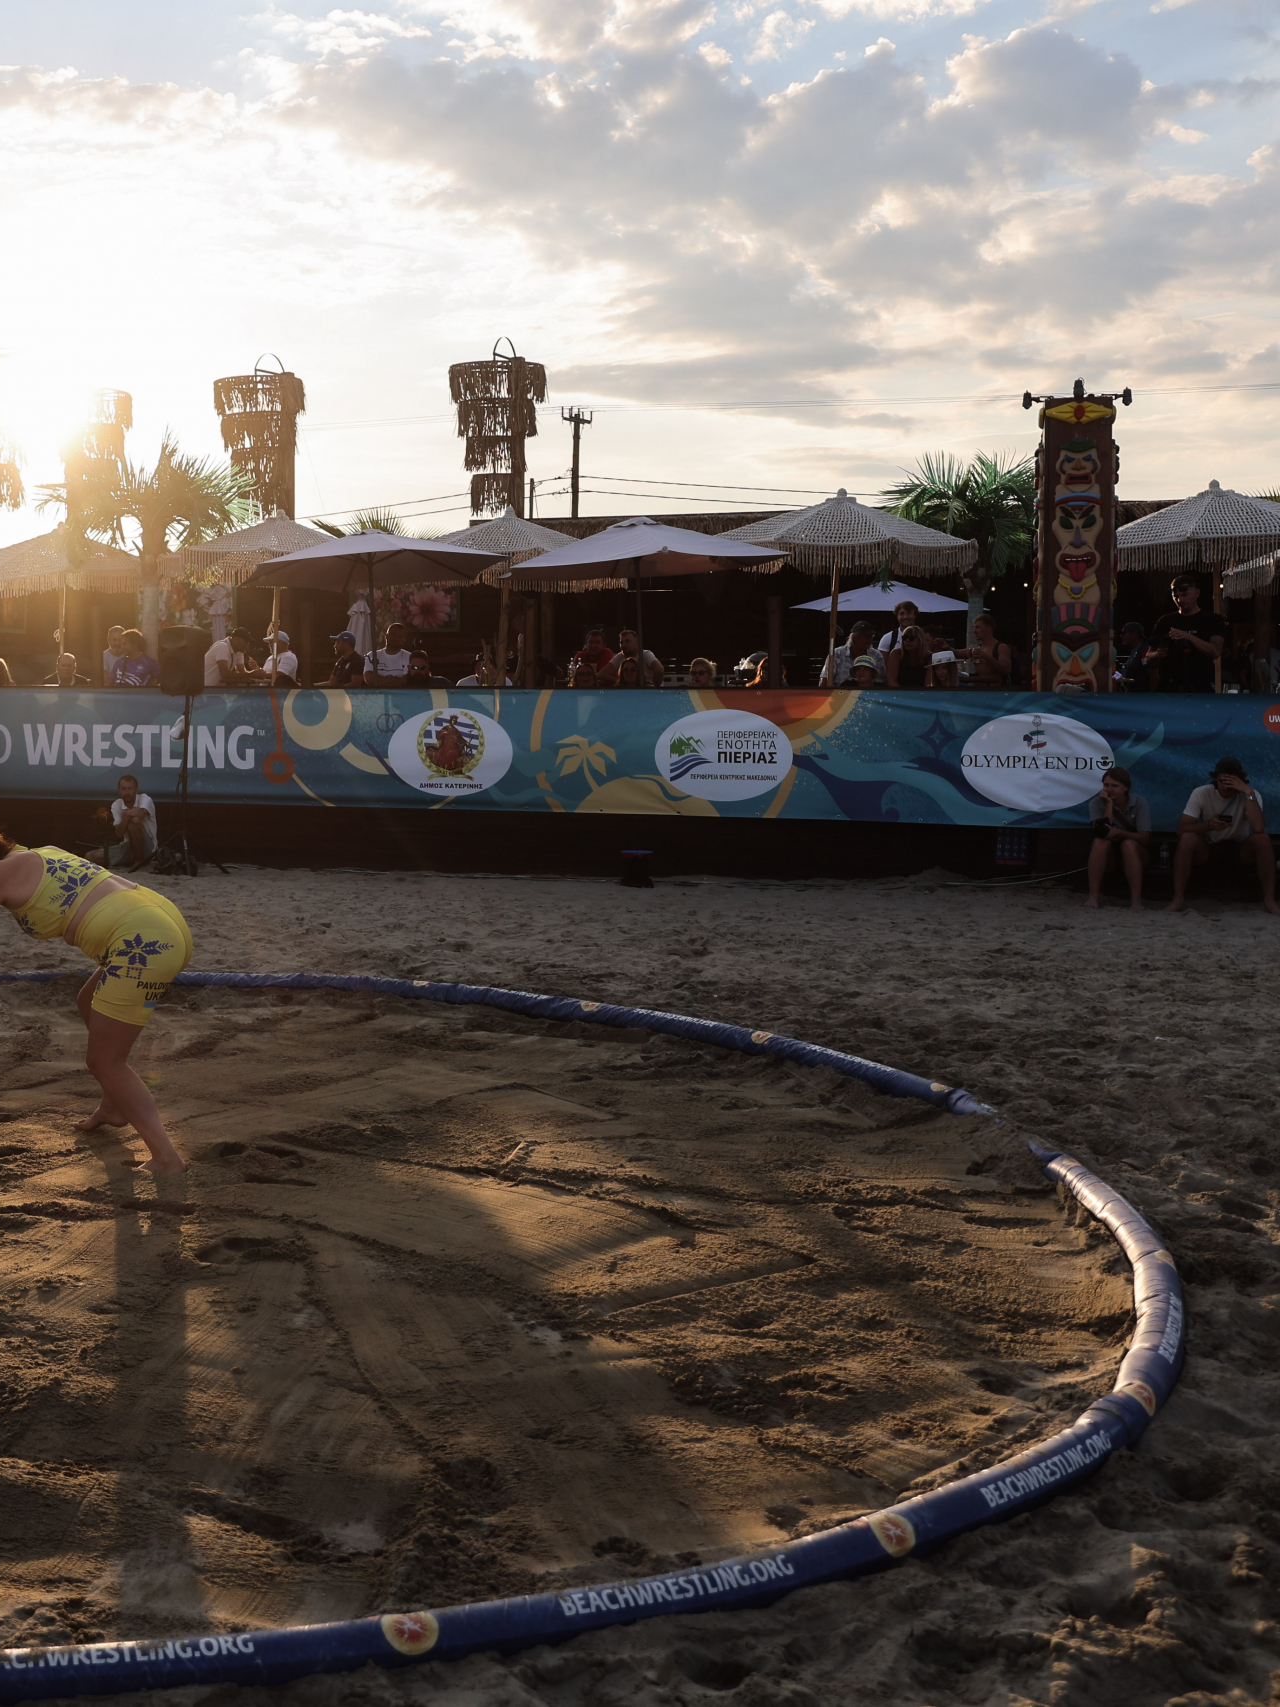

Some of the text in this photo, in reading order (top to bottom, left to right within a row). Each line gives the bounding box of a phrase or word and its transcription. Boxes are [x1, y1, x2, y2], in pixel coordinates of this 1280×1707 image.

[717, 730, 777, 739] ΠΕΡΙΦΕΡΕΙΑΚΗ
[23, 723, 255, 770] WRESTLING
[717, 740, 777, 750] ΕΝΟΤΗΤΑ
[717, 751, 777, 764] ΠΙΕΡΙΑΣ
[960, 754, 1039, 769] OLYMPIA
[1045, 756, 1069, 770] EN
[444, 782, 484, 790] ΚΑΤΕΡΙΝΗΣ
[980, 1429, 1112, 1508] BEACHWRESTLING.ORG
[559, 1554, 795, 1617] BEACHWRESTLING.ORG
